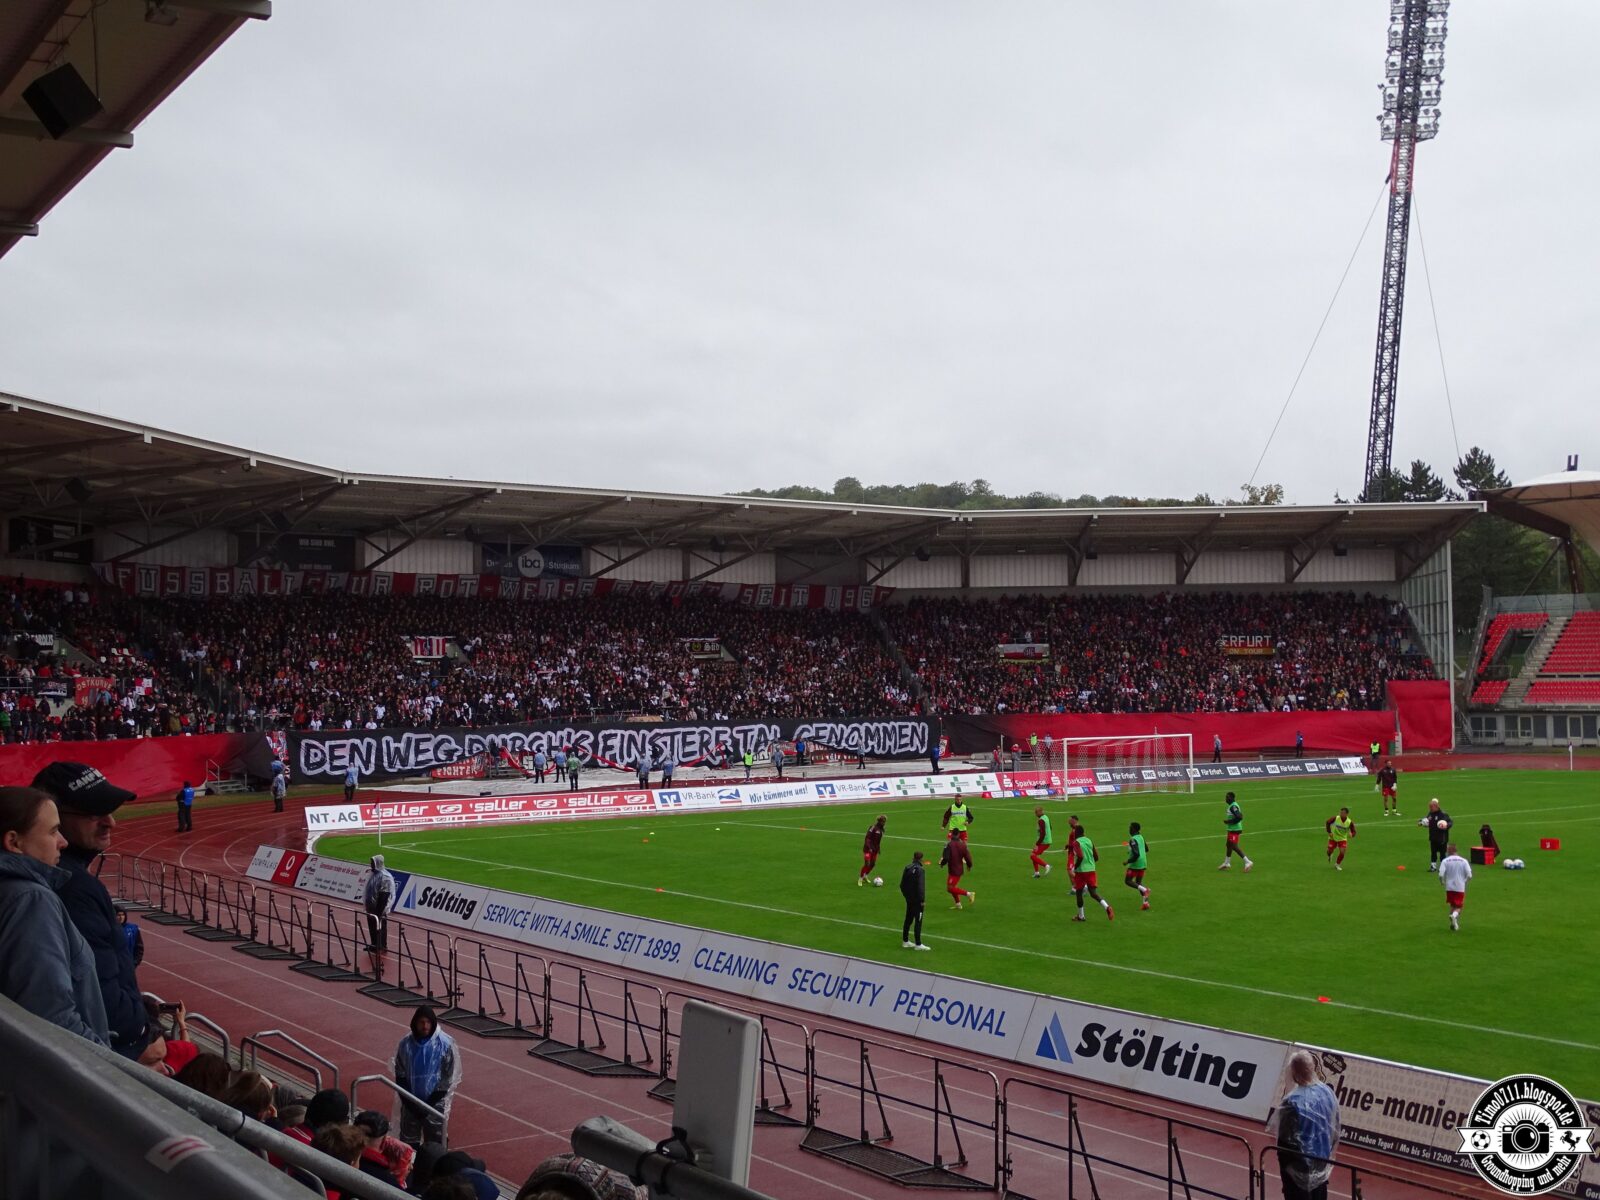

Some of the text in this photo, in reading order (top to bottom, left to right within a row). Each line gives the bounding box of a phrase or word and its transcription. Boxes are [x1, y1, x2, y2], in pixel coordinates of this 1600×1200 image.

[300, 737, 377, 776] DEN
[382, 733, 464, 772] WEG
[682, 790, 717, 800] VR-Bank
[749, 793, 763, 804] Wir
[791, 784, 809, 797] uns!
[836, 784, 867, 793] VR-Bank
[1014, 779, 1047, 788] Sparkasse
[418, 886, 477, 920] Stölting
[483, 903, 681, 964] SERVICE WITH A SMILE. SEIT 1899.
[693, 947, 1007, 1037] CLEANING SECURITY PERSONAL
[1074, 1021, 1258, 1099] Stölting
[1326, 1075, 1470, 1131] hne-manier
[1358, 1133, 1377, 1145] neben
[1399, 1143, 1410, 1154] Mo
[1411, 1147, 1420, 1156] bis
[1432, 1151, 1452, 1164] 12:00
